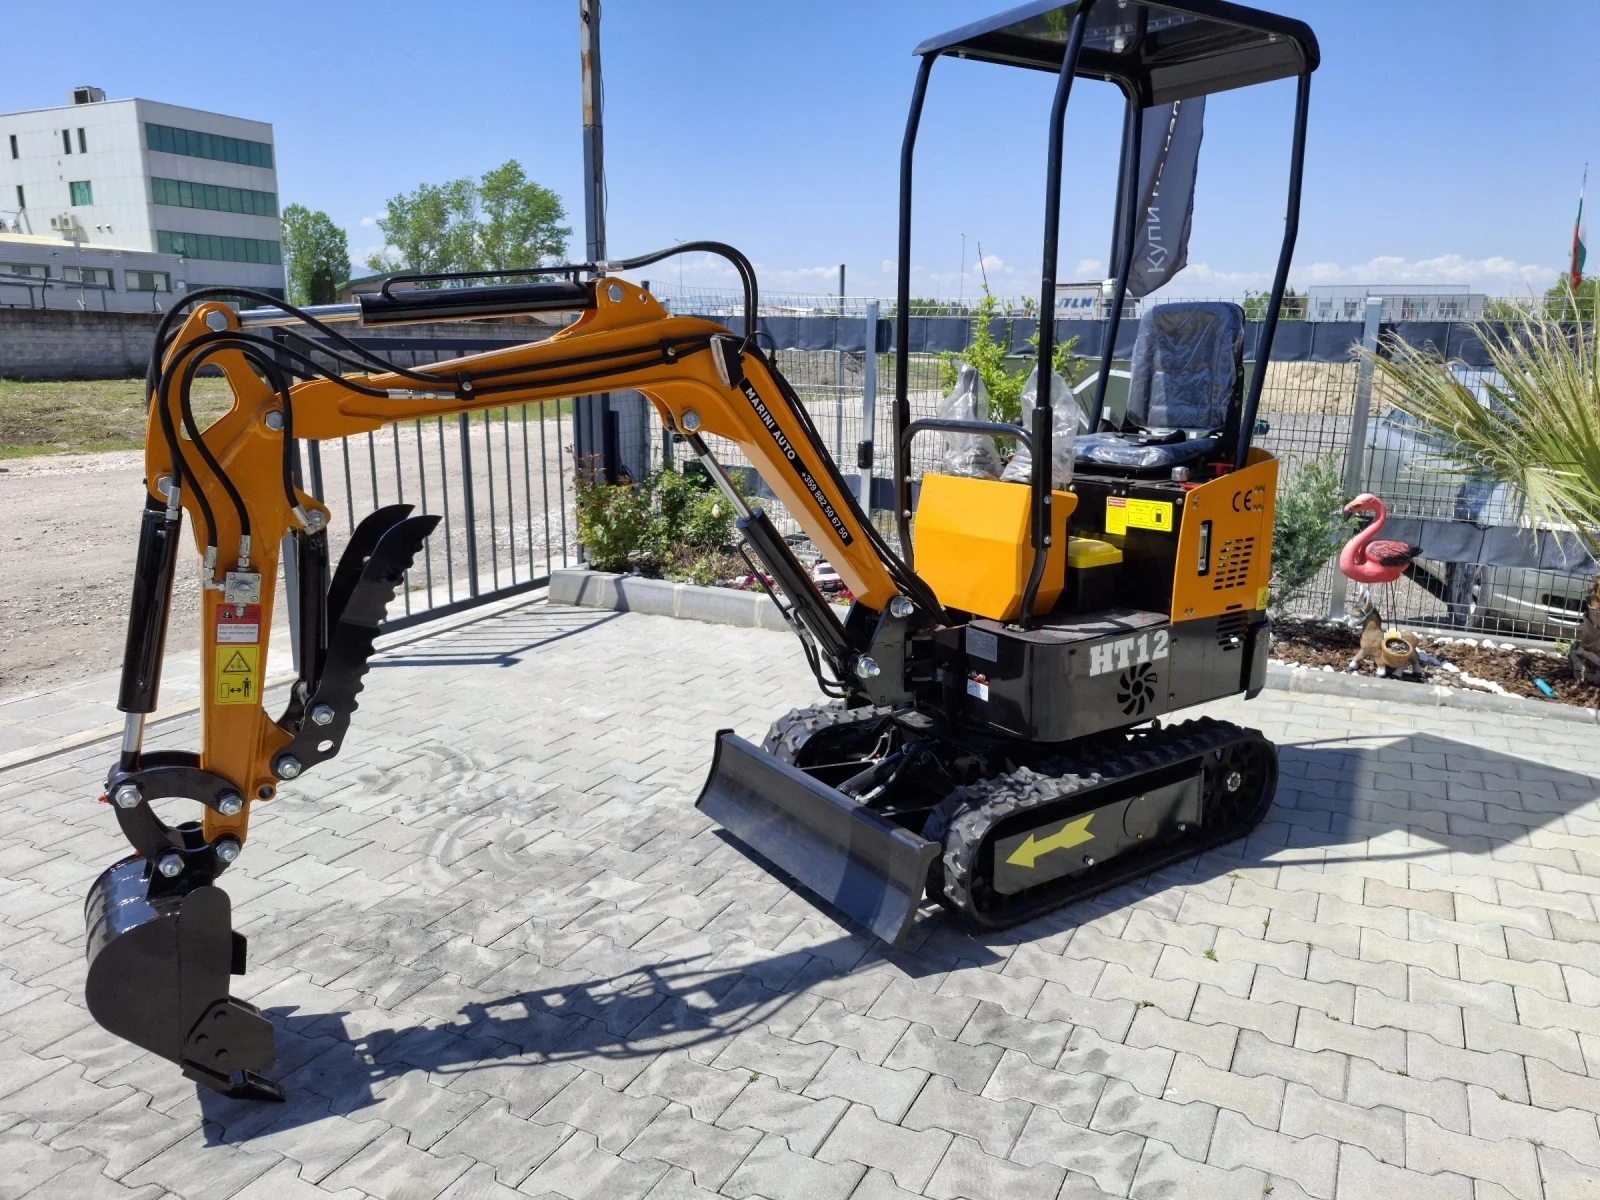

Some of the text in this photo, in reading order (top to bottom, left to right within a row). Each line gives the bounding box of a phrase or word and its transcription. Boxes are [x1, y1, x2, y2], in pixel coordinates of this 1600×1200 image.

[1147, 207, 1168, 273] Купи
[745, 387, 796, 460] MARINI AUTO
[801, 472, 848, 539] +359 882 50 67 50
[1232, 490, 1252, 512] CE
[1089, 629, 1169, 677] HT12
